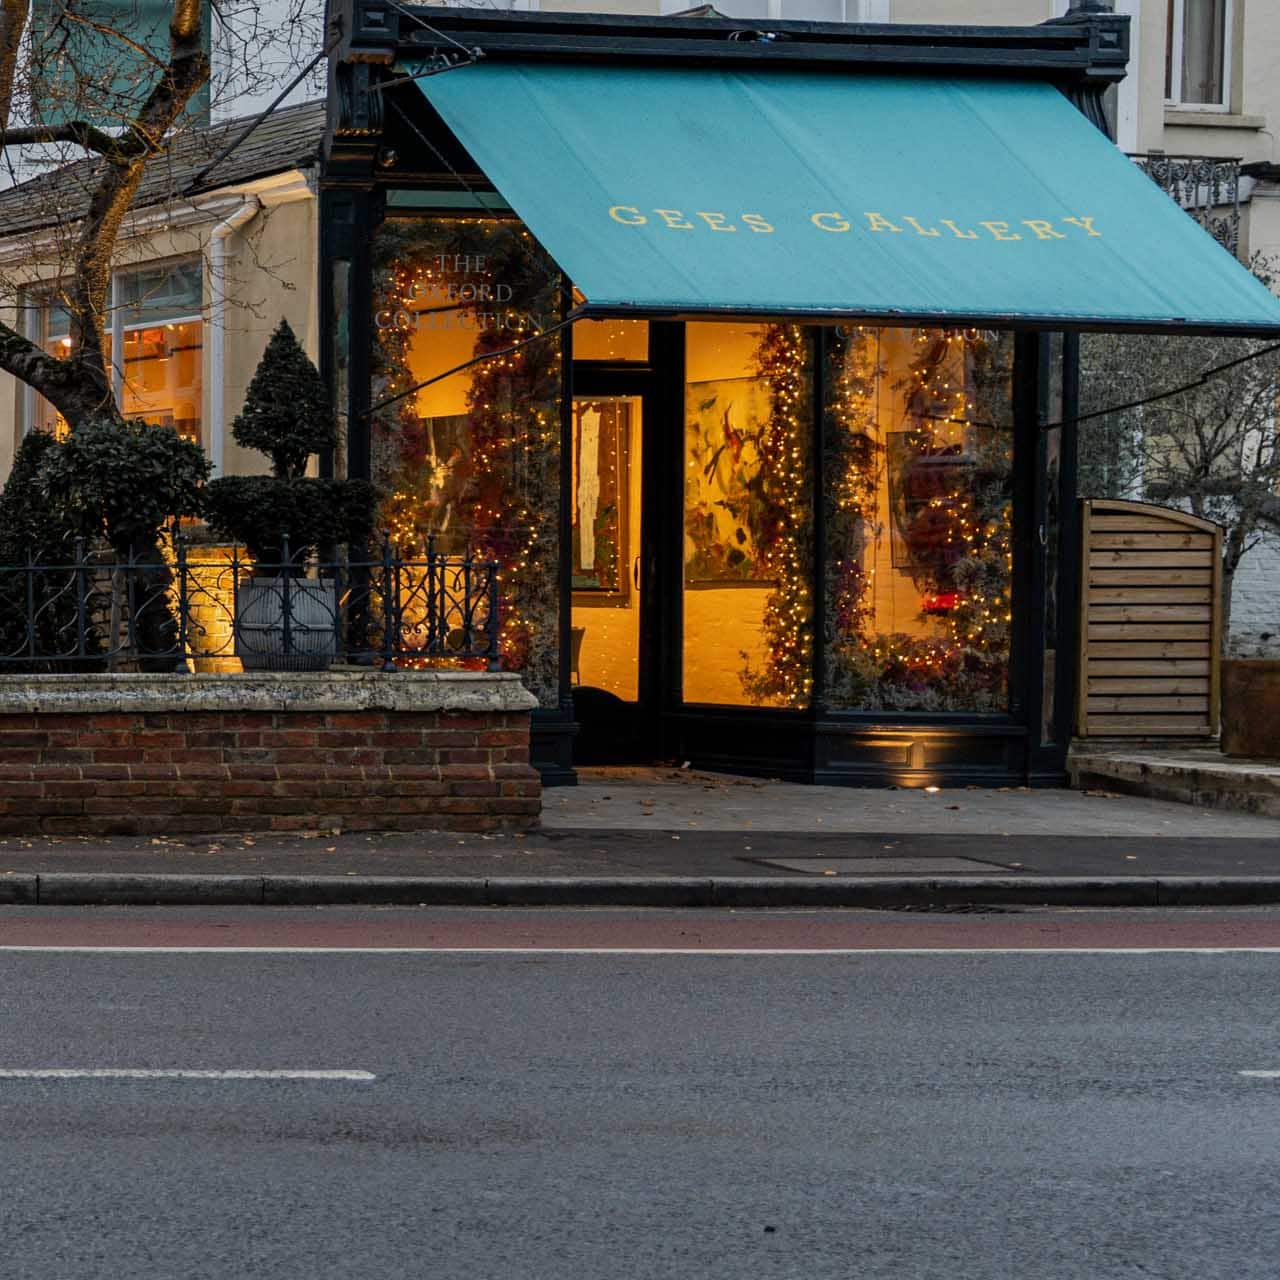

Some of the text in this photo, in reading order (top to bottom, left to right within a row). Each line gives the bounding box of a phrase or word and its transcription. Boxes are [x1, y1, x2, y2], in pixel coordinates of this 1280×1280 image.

[608, 206, 1103, 241] GEES GALLERY
[436, 254, 488, 273] THE
[408, 283, 513, 303] OXFORD
